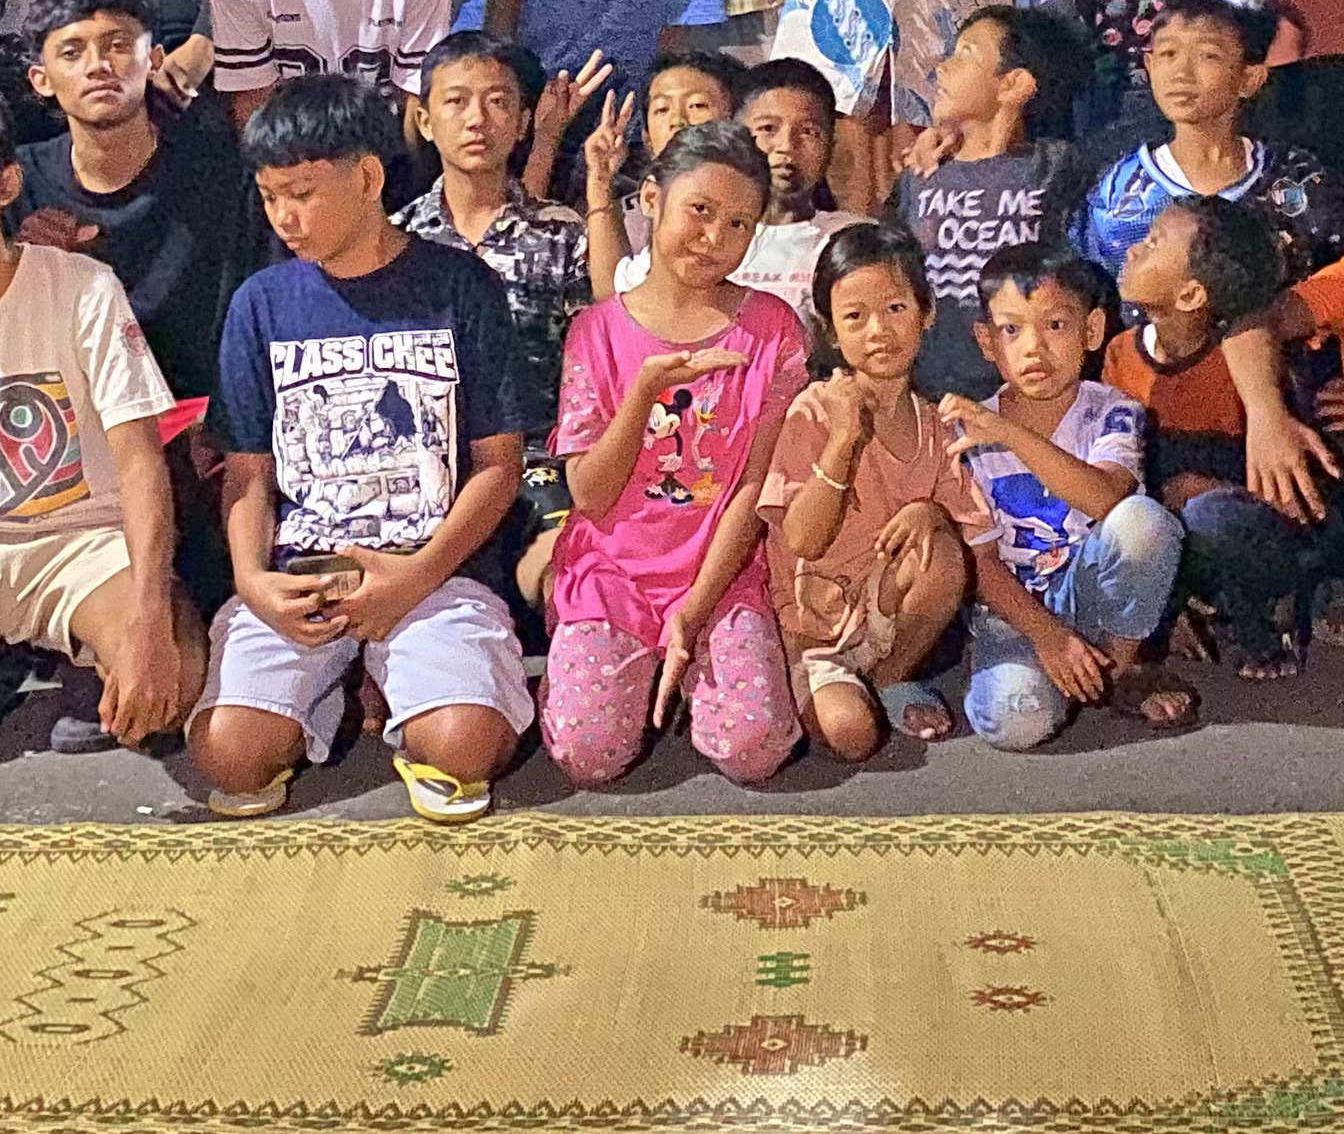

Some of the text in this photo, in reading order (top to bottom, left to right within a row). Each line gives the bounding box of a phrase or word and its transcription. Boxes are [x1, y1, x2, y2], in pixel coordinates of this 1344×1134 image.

[916, 188, 1046, 217] TAKE ME
[937, 218, 1042, 251] OCEAN
